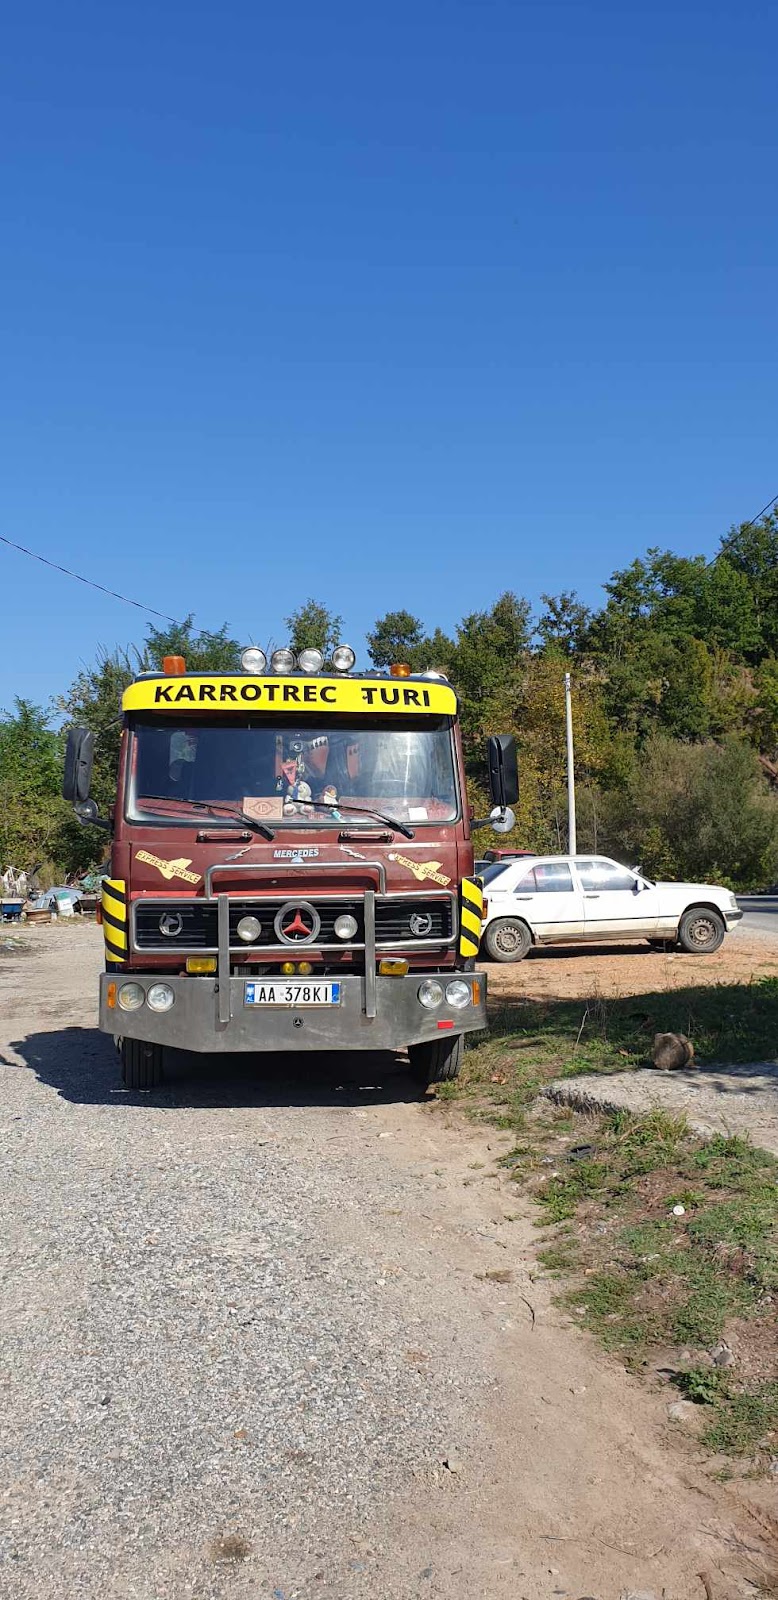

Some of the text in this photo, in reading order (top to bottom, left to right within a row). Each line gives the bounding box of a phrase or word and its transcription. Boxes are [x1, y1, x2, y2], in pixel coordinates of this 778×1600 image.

[154, 684, 430, 707] KARROTREC TURI
[273, 848, 319, 858] MERCEDES
[136, 851, 200, 883] EXPRESS SERVICE
[421, 867, 450, 885] SERVICE
[259, 987, 328, 1002] AA 378KI
